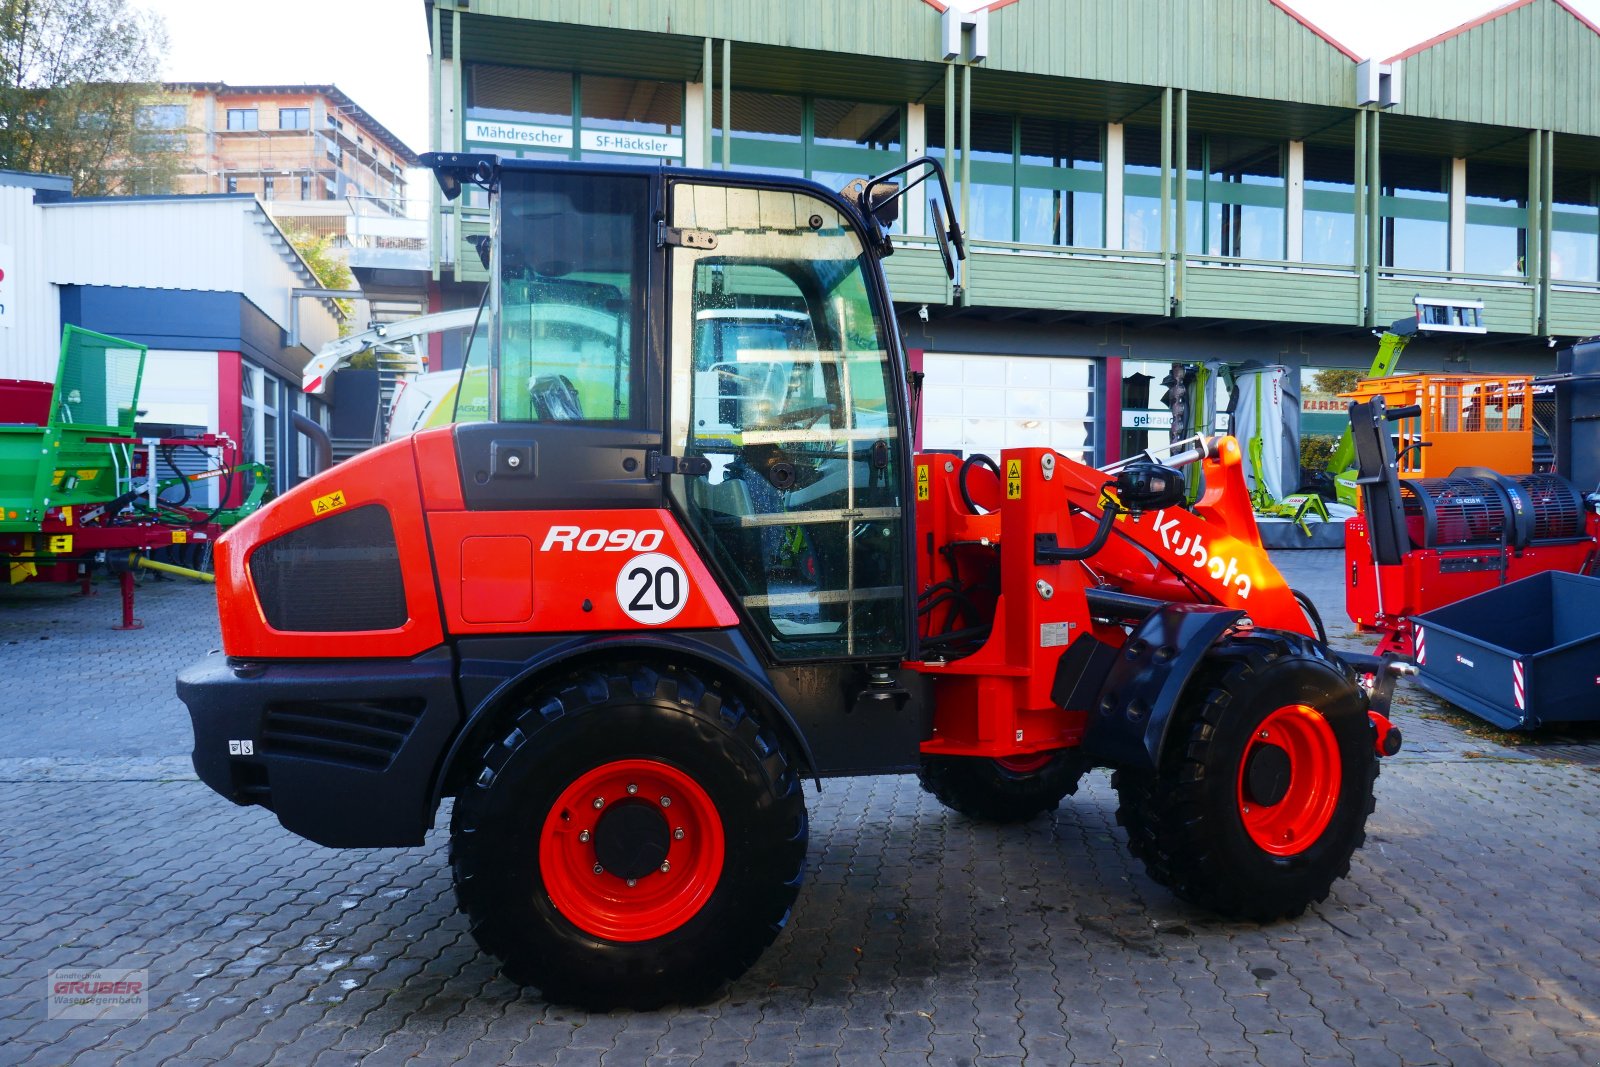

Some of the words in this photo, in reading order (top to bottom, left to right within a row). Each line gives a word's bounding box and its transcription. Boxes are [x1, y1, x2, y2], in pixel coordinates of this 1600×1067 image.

[476, 124, 564, 144] Mähdrescher
[596, 135, 668, 152] SF-Häcksler
[1303, 400, 1349, 411] CLAAS
[1133, 413, 1174, 427] gebrauc
[540, 525, 664, 552] R090
[1152, 509, 1252, 600] Kubota
[628, 566, 680, 612] 20
